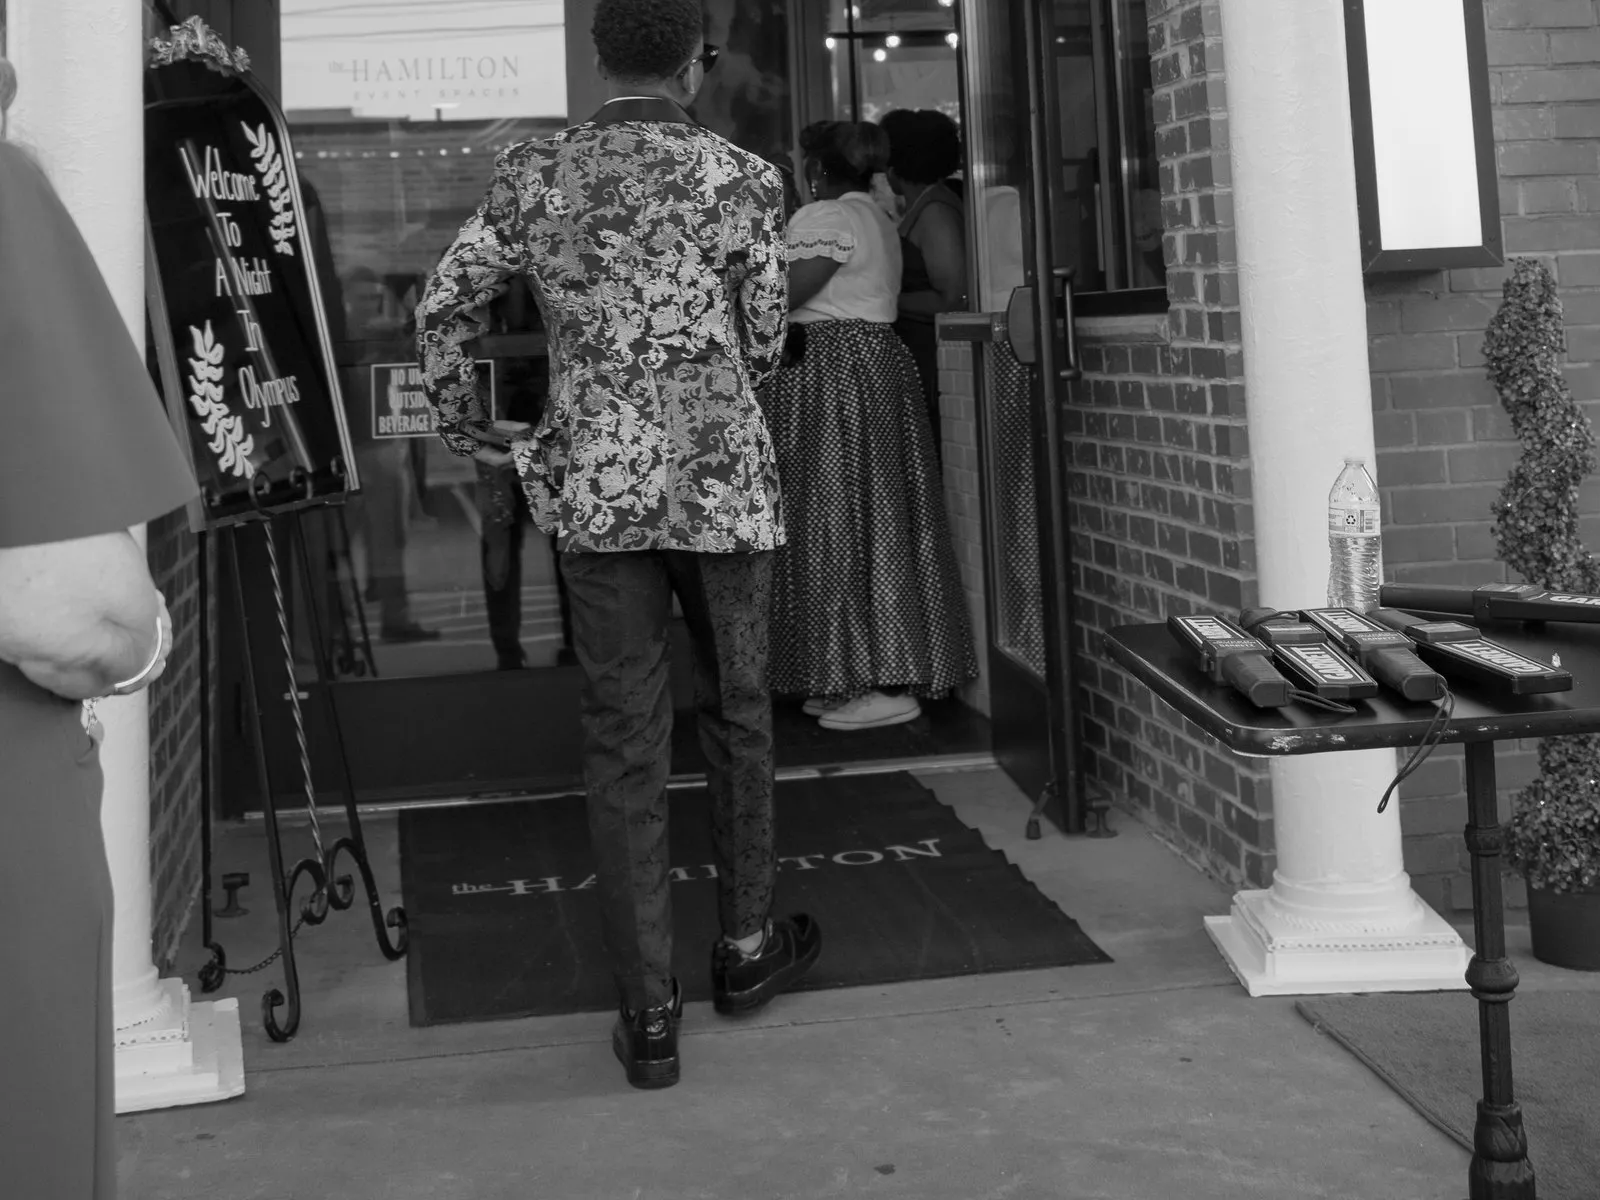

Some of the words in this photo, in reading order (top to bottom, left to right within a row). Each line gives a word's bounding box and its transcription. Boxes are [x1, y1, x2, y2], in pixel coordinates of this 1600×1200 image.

[351, 56, 519, 82] HAMILTON
[180, 145, 260, 201] Welcome
[216, 212, 242, 247] To
[216, 258, 232, 297] A
[231, 257, 272, 296] Night
[237, 309, 264, 352] In
[390, 368, 405, 385] NO
[238, 364, 300, 428] Olympus
[378, 414, 428, 433] BEVERAGE
[1290, 647, 1354, 680] GARRETT
[1451, 643, 1542, 672] GARRETT
[452, 882, 493, 894] the
